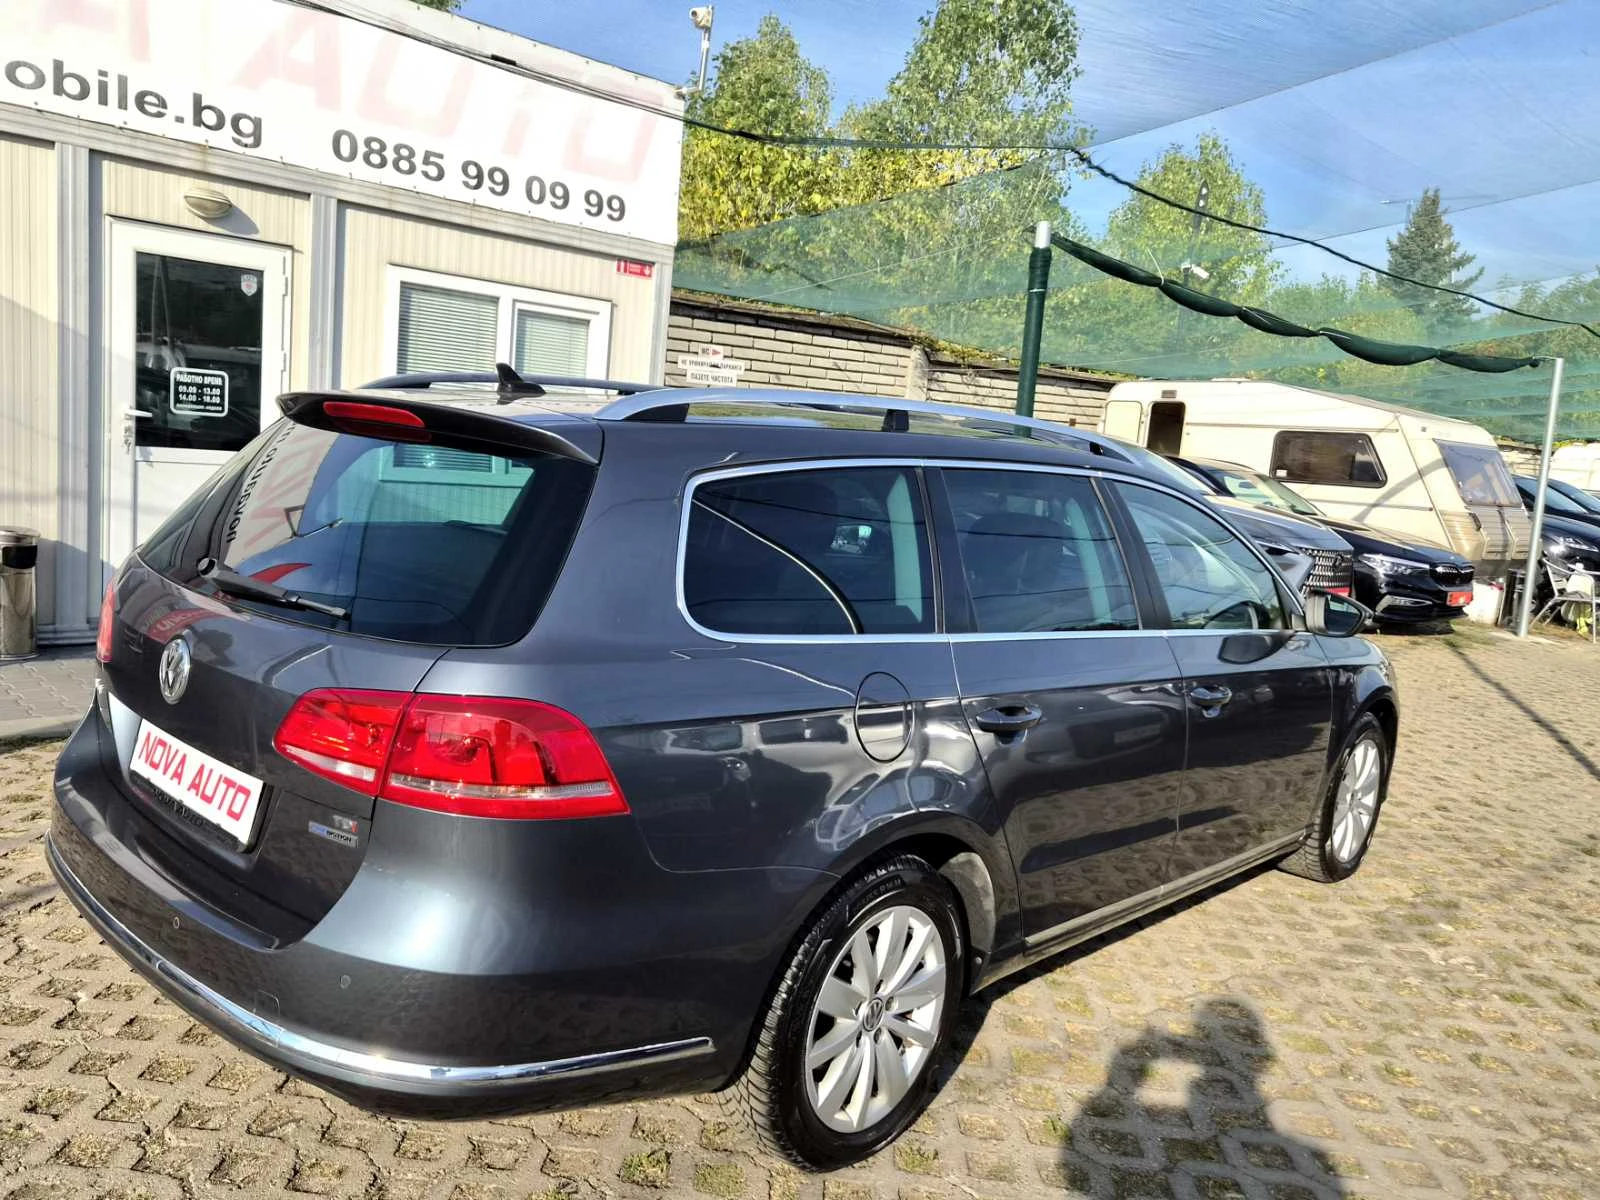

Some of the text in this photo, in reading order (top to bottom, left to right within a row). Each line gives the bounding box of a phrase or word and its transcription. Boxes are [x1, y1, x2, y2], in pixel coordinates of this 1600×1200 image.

[332, 129, 626, 222] 0885 99 09 99
[176, 373, 202, 384] РАБОТНО
[711, 375, 733, 383] ЧИСТОТА
[138, 731, 252, 822] NOVA AUTO
